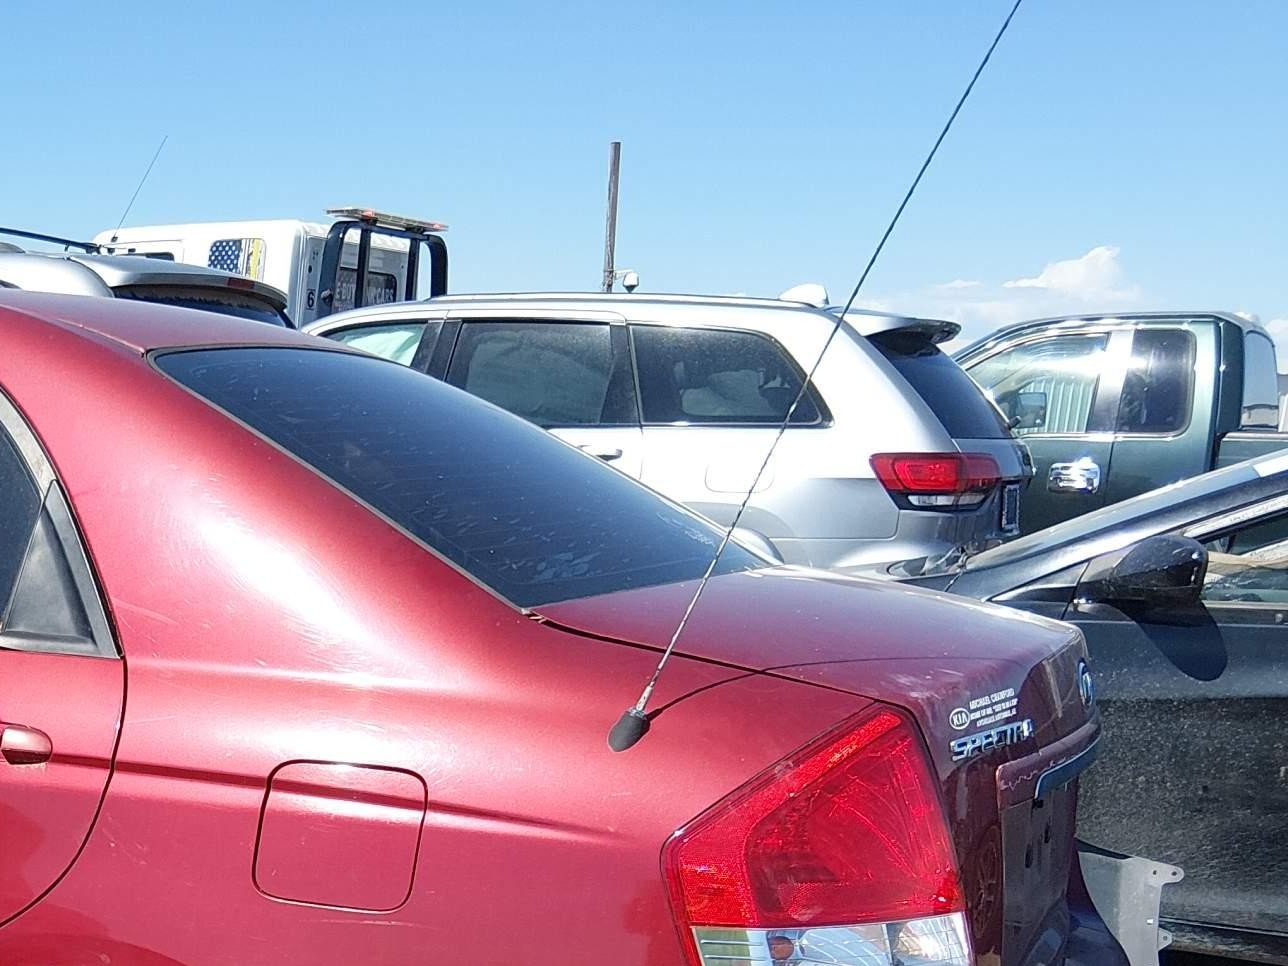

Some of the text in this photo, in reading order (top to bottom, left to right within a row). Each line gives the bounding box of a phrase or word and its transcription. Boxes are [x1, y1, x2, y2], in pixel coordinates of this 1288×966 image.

[307, 290, 315, 309] 6
[951, 710, 969, 728] KIA
[950, 718, 1034, 762] SPECTRA
